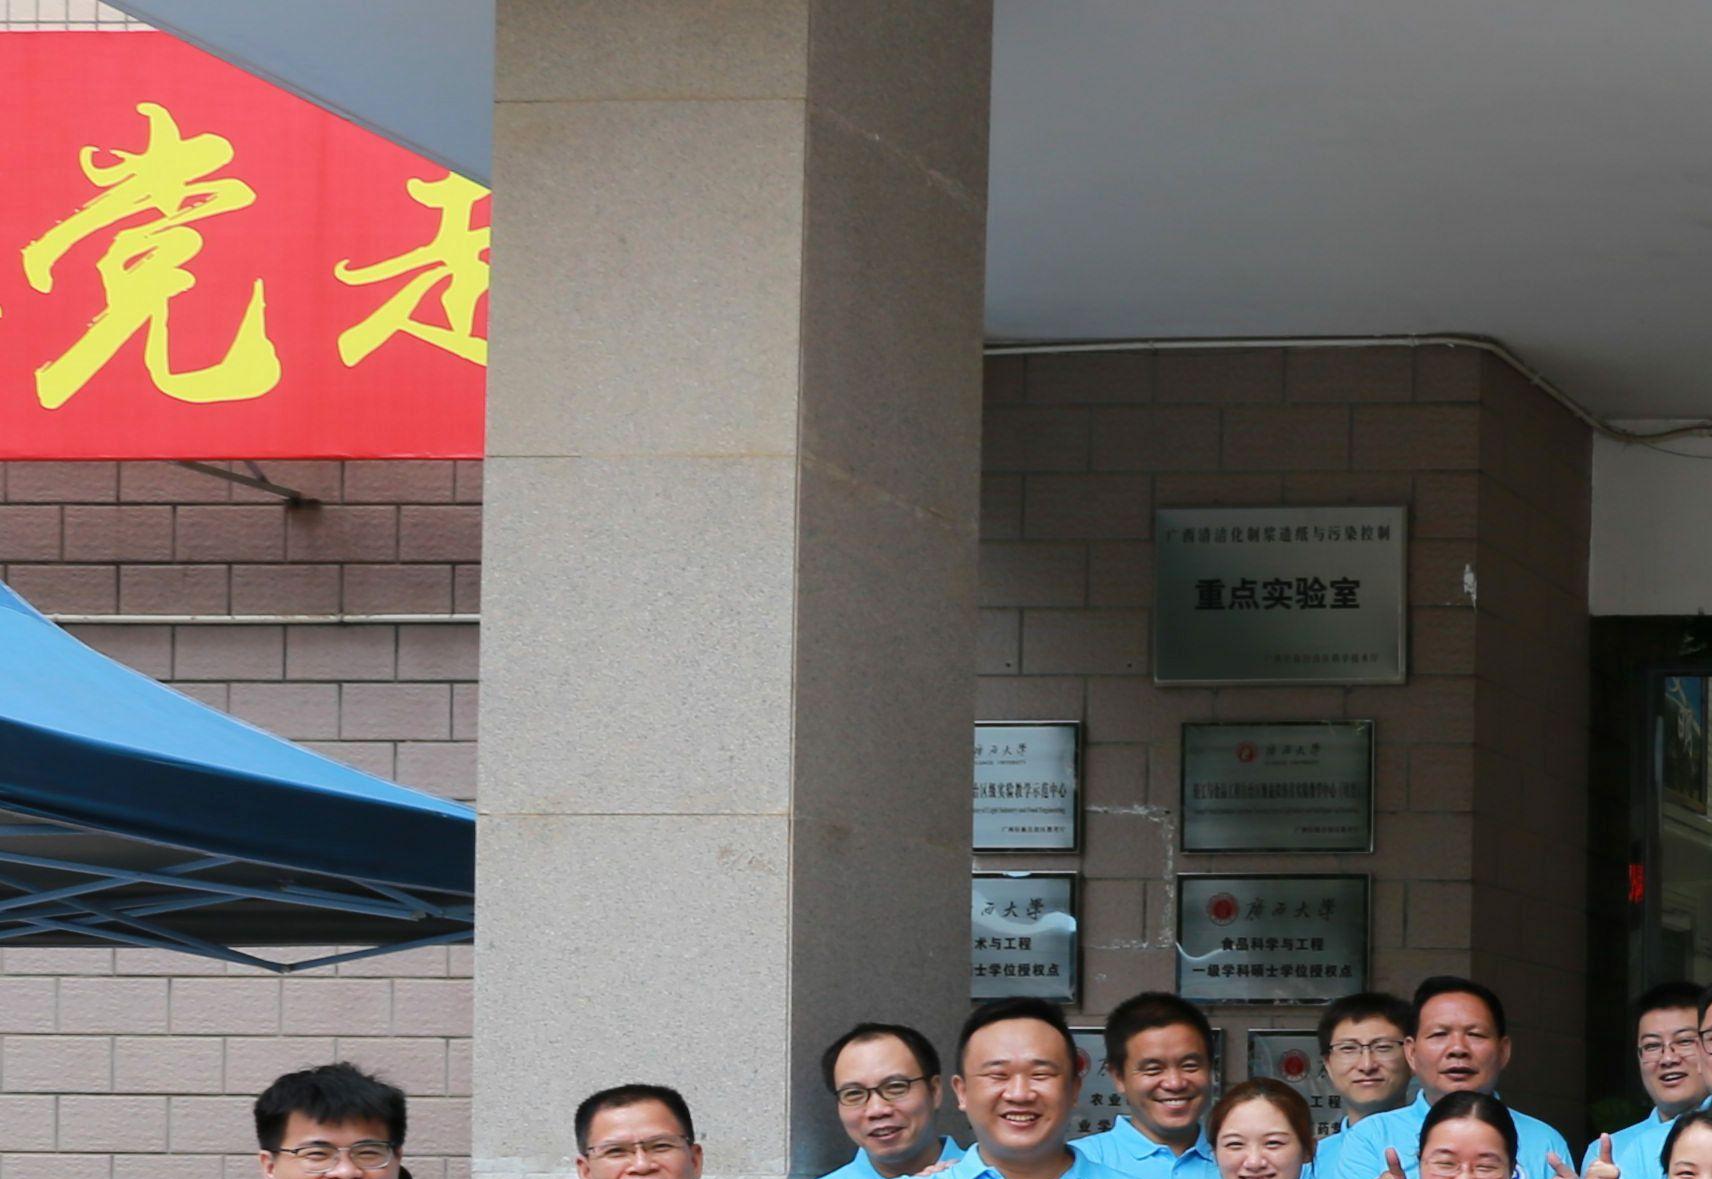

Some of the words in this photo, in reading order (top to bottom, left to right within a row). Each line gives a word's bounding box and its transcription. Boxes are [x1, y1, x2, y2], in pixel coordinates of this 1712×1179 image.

[1165, 525, 1391, 543] 广西清洁化制浆造纸与污染控制
[1195, 577, 1361, 610] 重点实验室
[975, 937, 1031, 950] 术与工程
[1222, 937, 1325, 951] 食品科学与工程
[975, 963, 1059, 977] 士学位授权点
[1192, 964, 1353, 978] 一级学科硕士学位授权点
